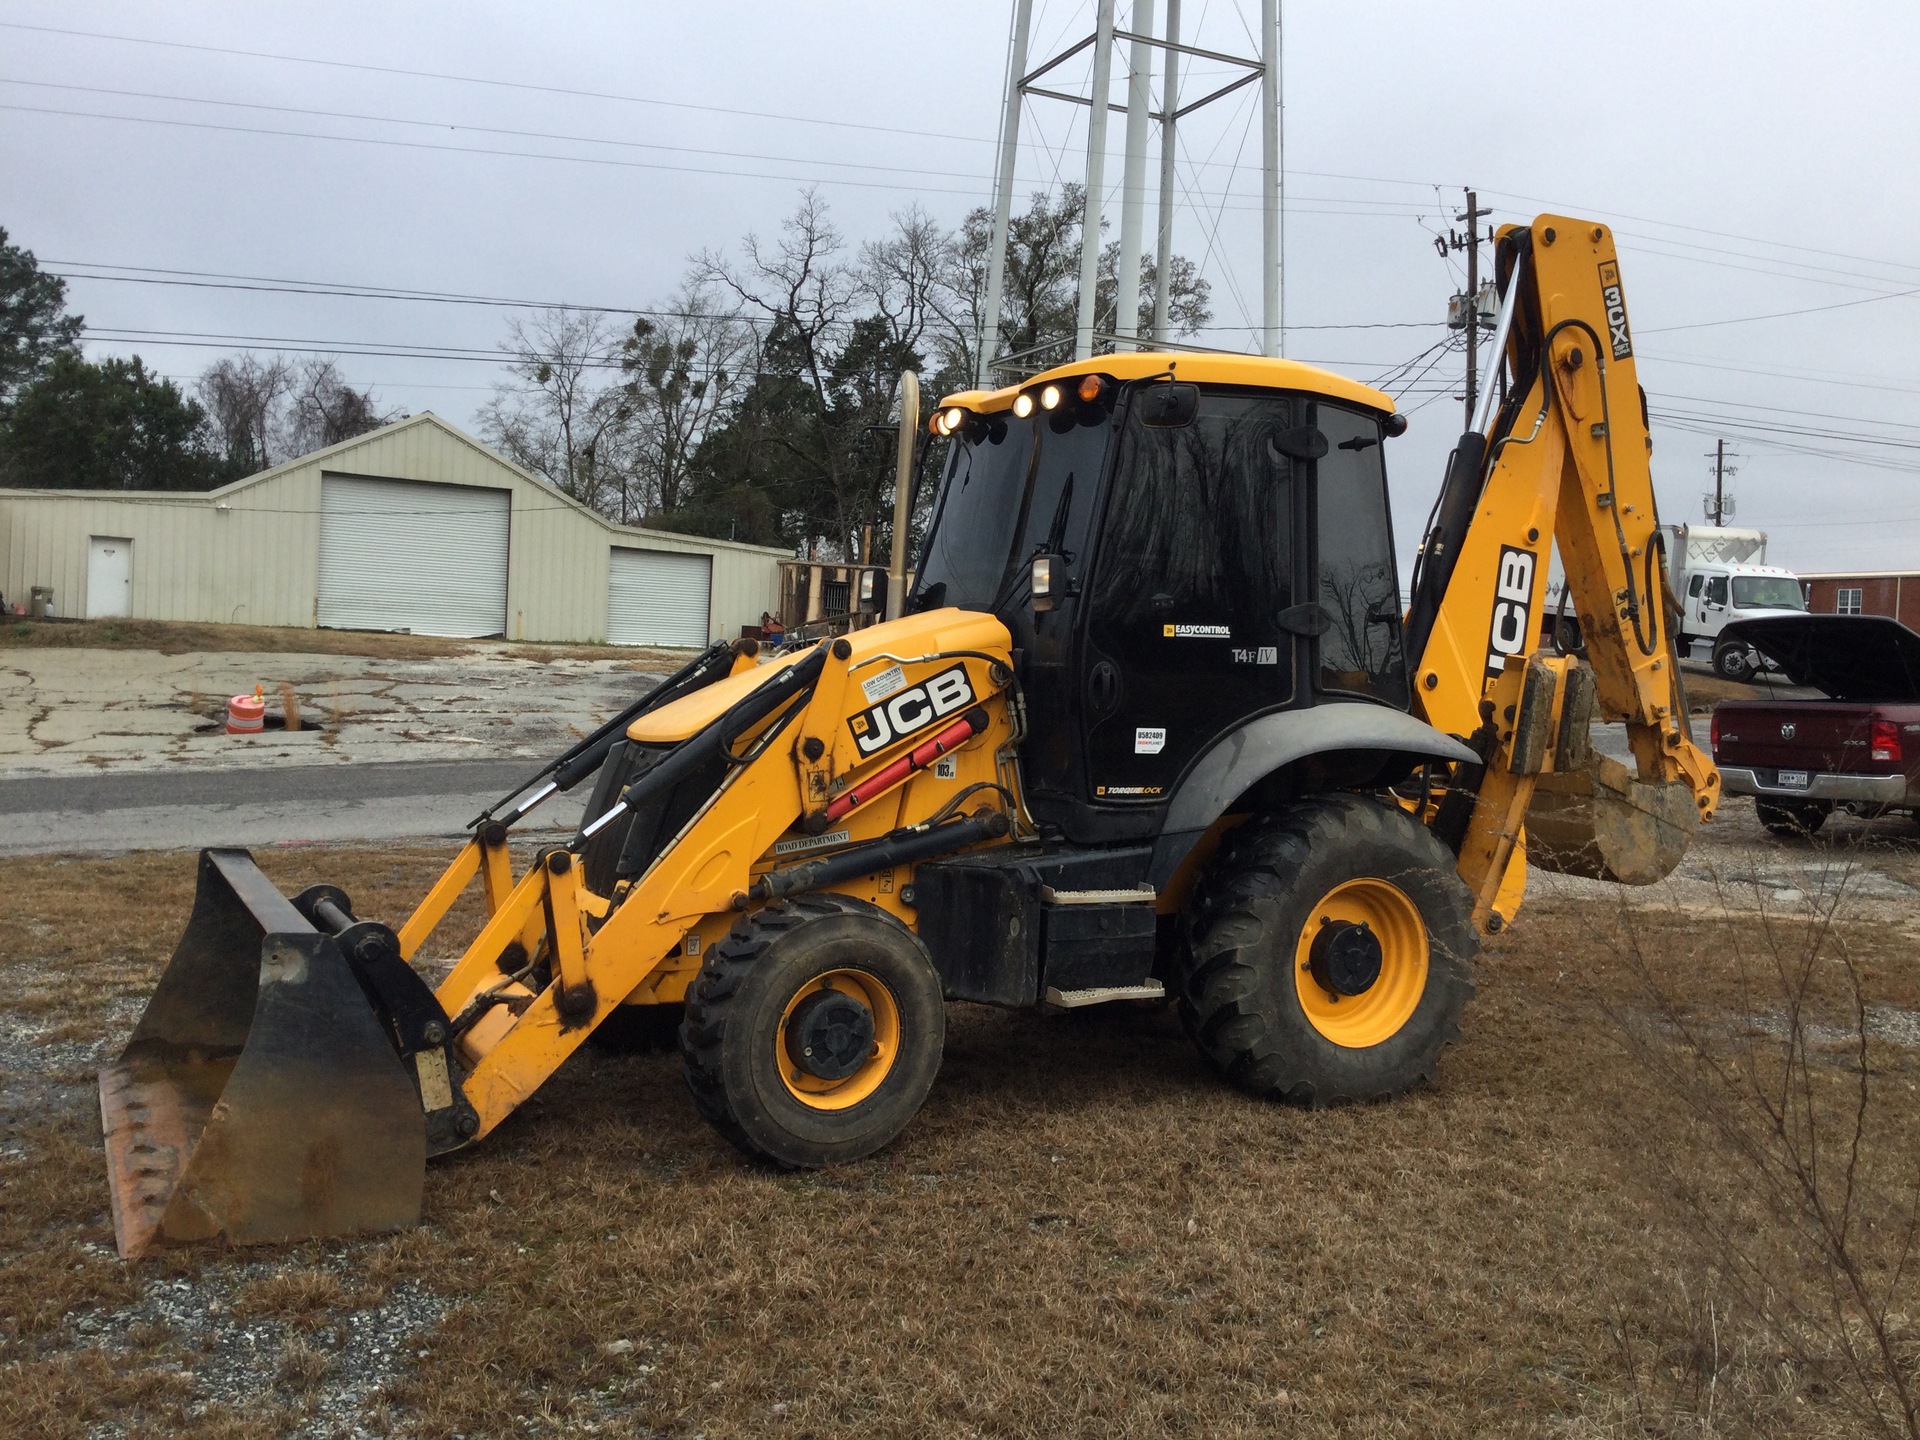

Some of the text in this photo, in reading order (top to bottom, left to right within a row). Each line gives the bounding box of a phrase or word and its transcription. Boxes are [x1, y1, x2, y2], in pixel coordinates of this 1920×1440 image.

[1604, 286, 1629, 346] 3CX
[1488, 551, 1533, 670] CB
[1175, 624, 1231, 636] EASYCONTROL
[863, 679, 877, 689] LOW
[875, 667, 901, 684] COUNTRY
[858, 669, 971, 752] JCB
[937, 764, 950, 777] 103
[1107, 786, 1163, 795] TORQUELOCK
[776, 832, 848, 853] ROAD DEPARTMENT
